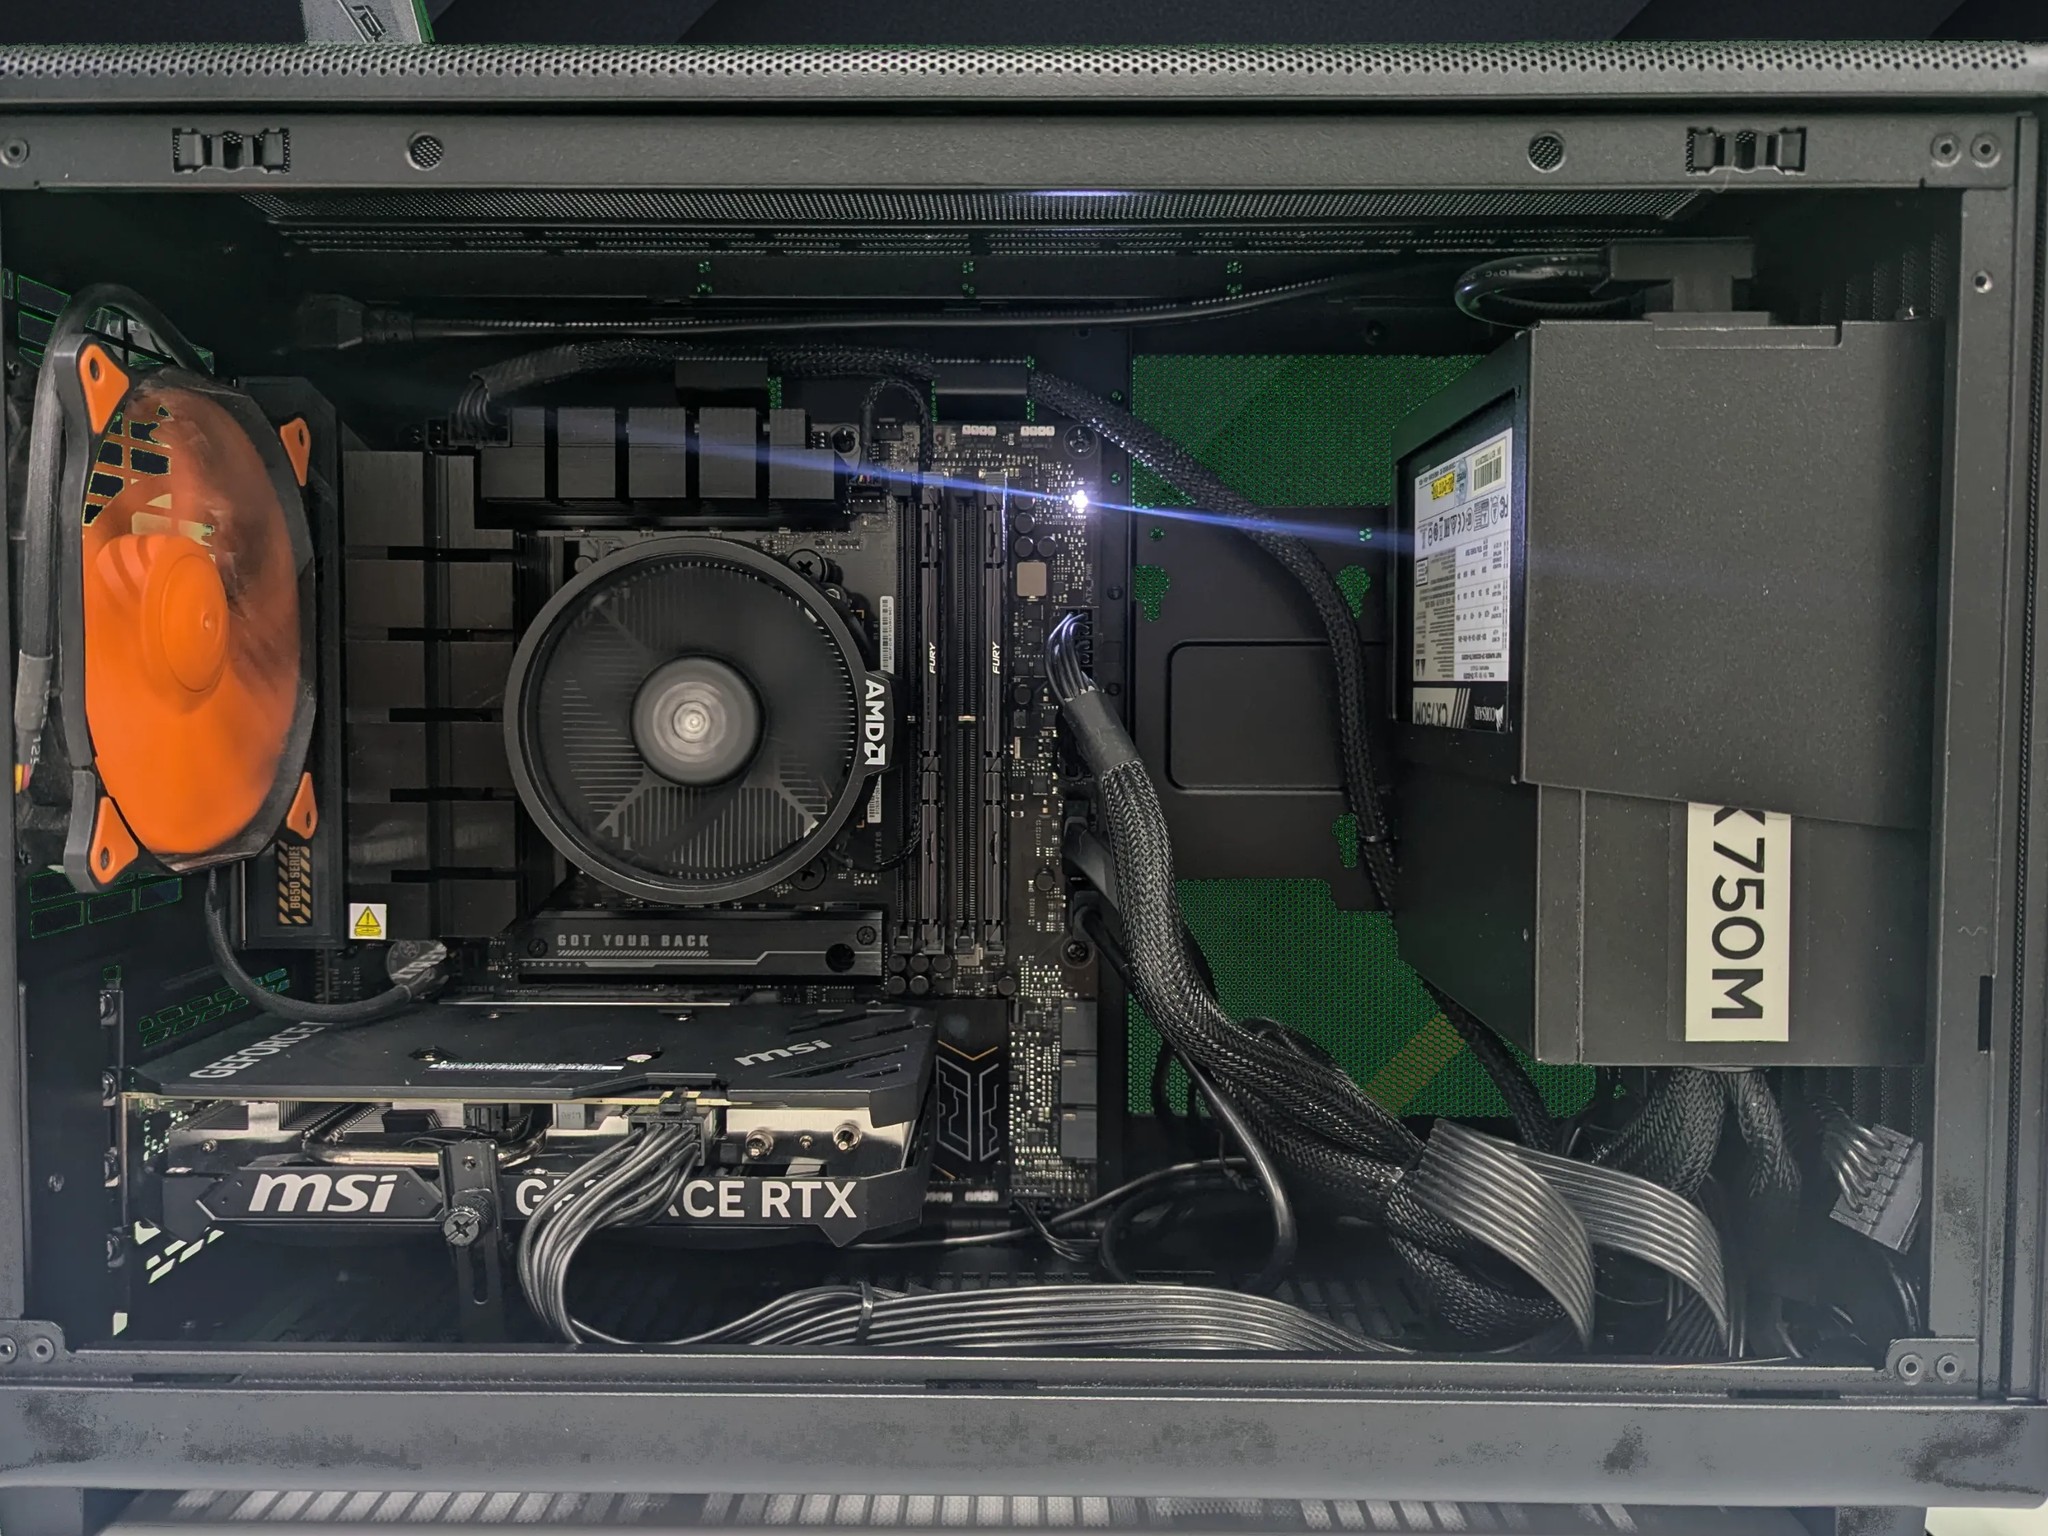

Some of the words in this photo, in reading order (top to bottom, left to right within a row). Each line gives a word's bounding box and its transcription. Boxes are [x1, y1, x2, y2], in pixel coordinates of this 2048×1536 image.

[928, 641, 937, 674] FURY
[992, 641, 1001, 674] FURY
[865, 679, 885, 741] AMD
[289, 881, 301, 909] B650
[557, 934, 592, 947] GOT
[602, 934, 650, 947] YOUR
[661, 934, 709, 947] BACK
[189, 1025, 326, 1079] GEFORCE
[734, 1039, 832, 1067] msi
[248, 1172, 398, 1213] msi
[761, 1181, 857, 1219] RTX
